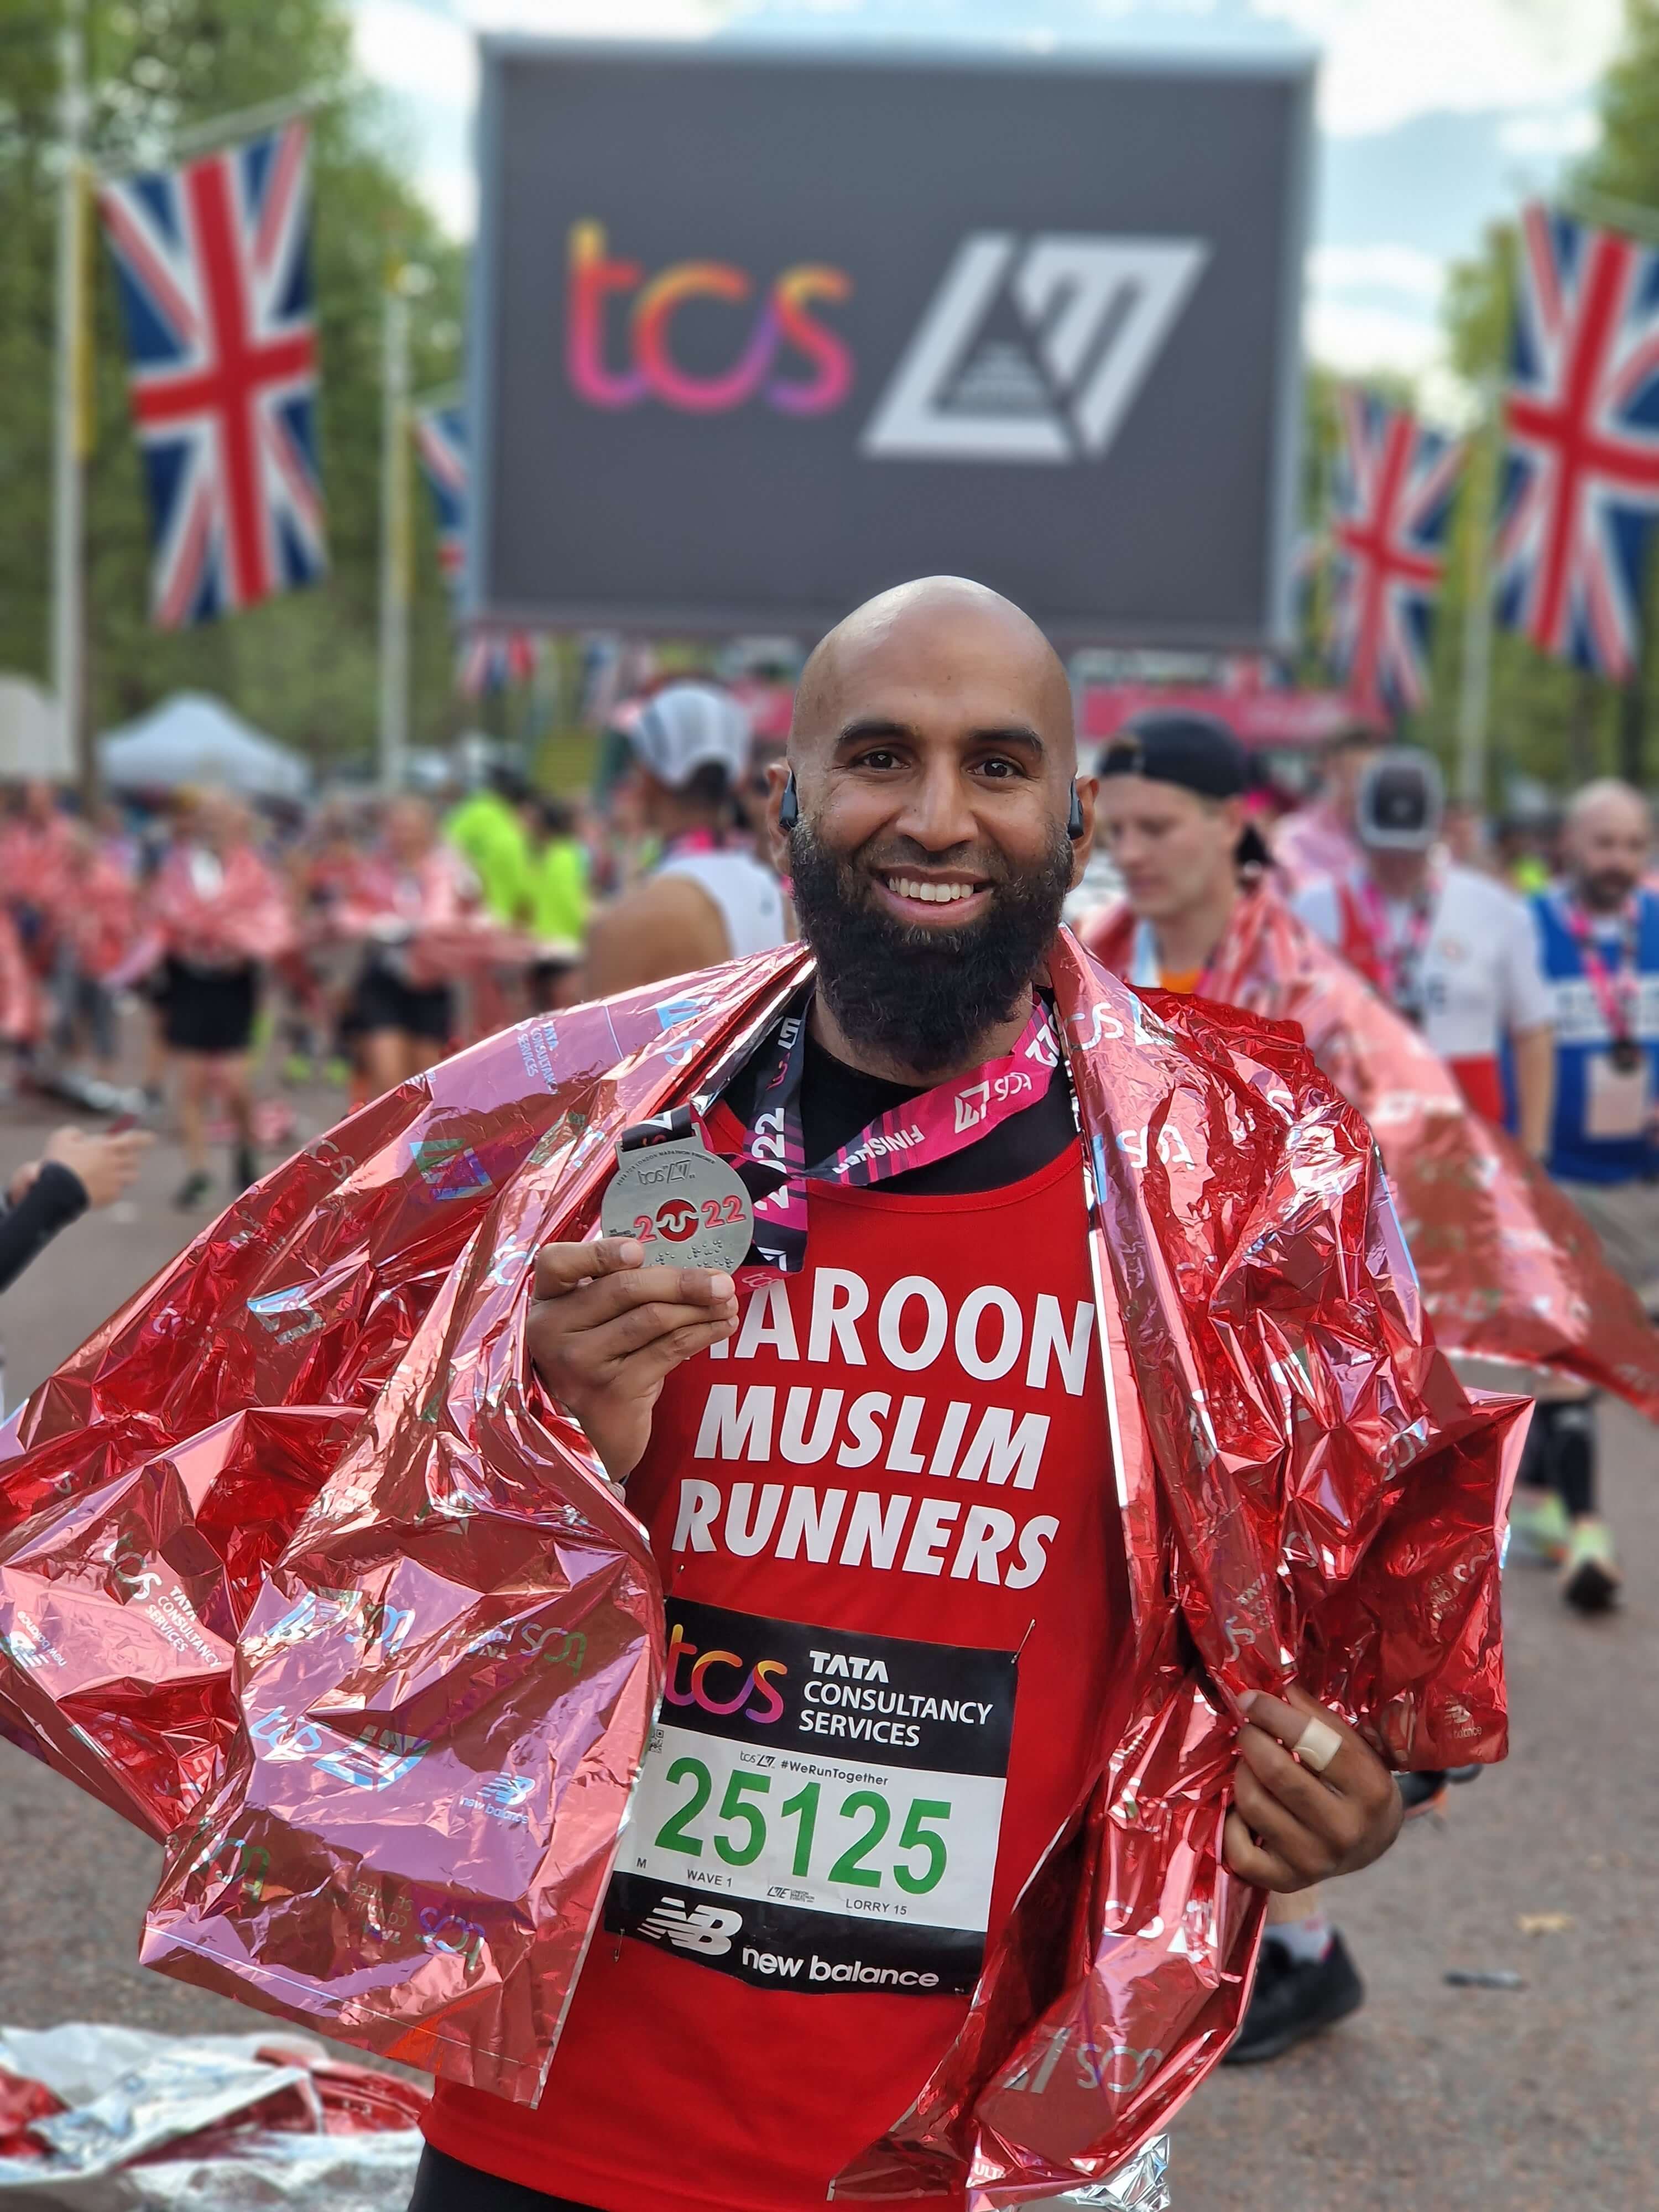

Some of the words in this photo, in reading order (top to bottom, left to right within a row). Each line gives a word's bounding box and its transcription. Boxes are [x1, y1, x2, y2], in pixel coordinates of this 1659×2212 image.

[565, 218, 854, 414] tcs
[994, 1072, 1032, 1101] tcs
[638, 1168, 665, 1185] tcs
[684, 1267, 1094, 1396] AROON
[693, 1384, 1051, 1490] MUSLIM
[672, 1479, 1060, 1589] RUNNERS
[169, 1585, 197, 1622] TATA
[145, 1604, 189, 1652] SERVICES
[157, 1595, 222, 1668] CONSULTANCY
[520, 1623, 587, 1677] tcs
[809, 1651, 889, 1683] TATA
[664, 1624, 787, 1724] tcs
[804, 1681, 994, 1726] CONSULTANCY
[799, 1709, 920, 1747] SERVICES
[740, 1750, 755, 1763] tcs
[781, 1760, 889, 1786] #WeRunTogether
[655, 1756, 952, 1894] 25125
[637, 1858, 647, 1869] M
[687, 1869, 723, 1886] WAVE
[726, 1877, 733, 1887] 1
[846, 1898, 890, 1914] LORRY
[893, 1904, 907, 1915] 15
[742, 1946, 804, 1981] new
[810, 1954, 939, 1988] balance
